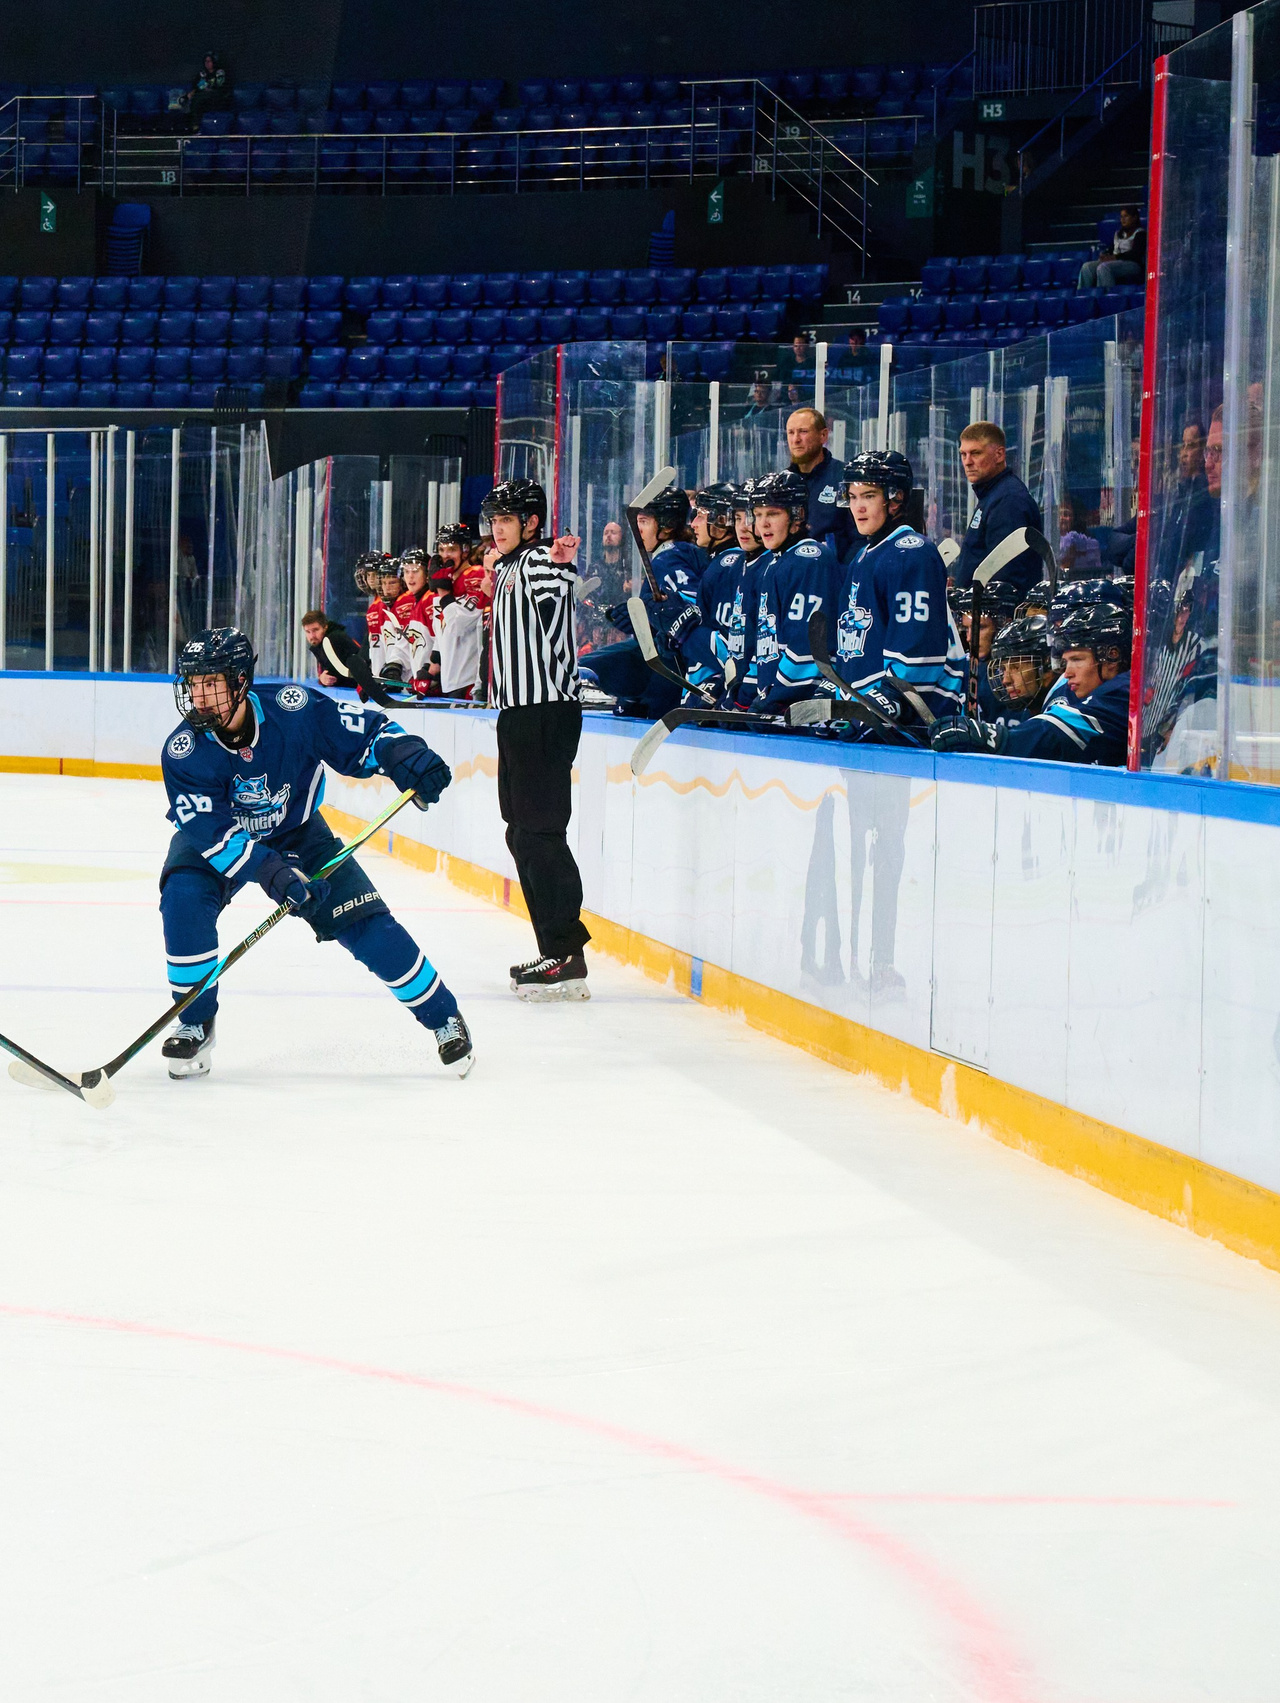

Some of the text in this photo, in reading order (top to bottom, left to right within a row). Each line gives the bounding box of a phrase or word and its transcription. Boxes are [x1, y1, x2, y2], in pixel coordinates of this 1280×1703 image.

[982, 104, 1003, 118] H3
[785, 126, 800, 138] 19
[754, 160, 768, 172] 18
[952, 130, 1011, 194] H3
[160, 170, 176, 184] 18
[846, 290, 861, 304] 14
[663, 569, 690, 593] 14
[787, 593, 822, 622] 97
[895, 590, 930, 623] 35
[176, 793, 213, 825] 26
